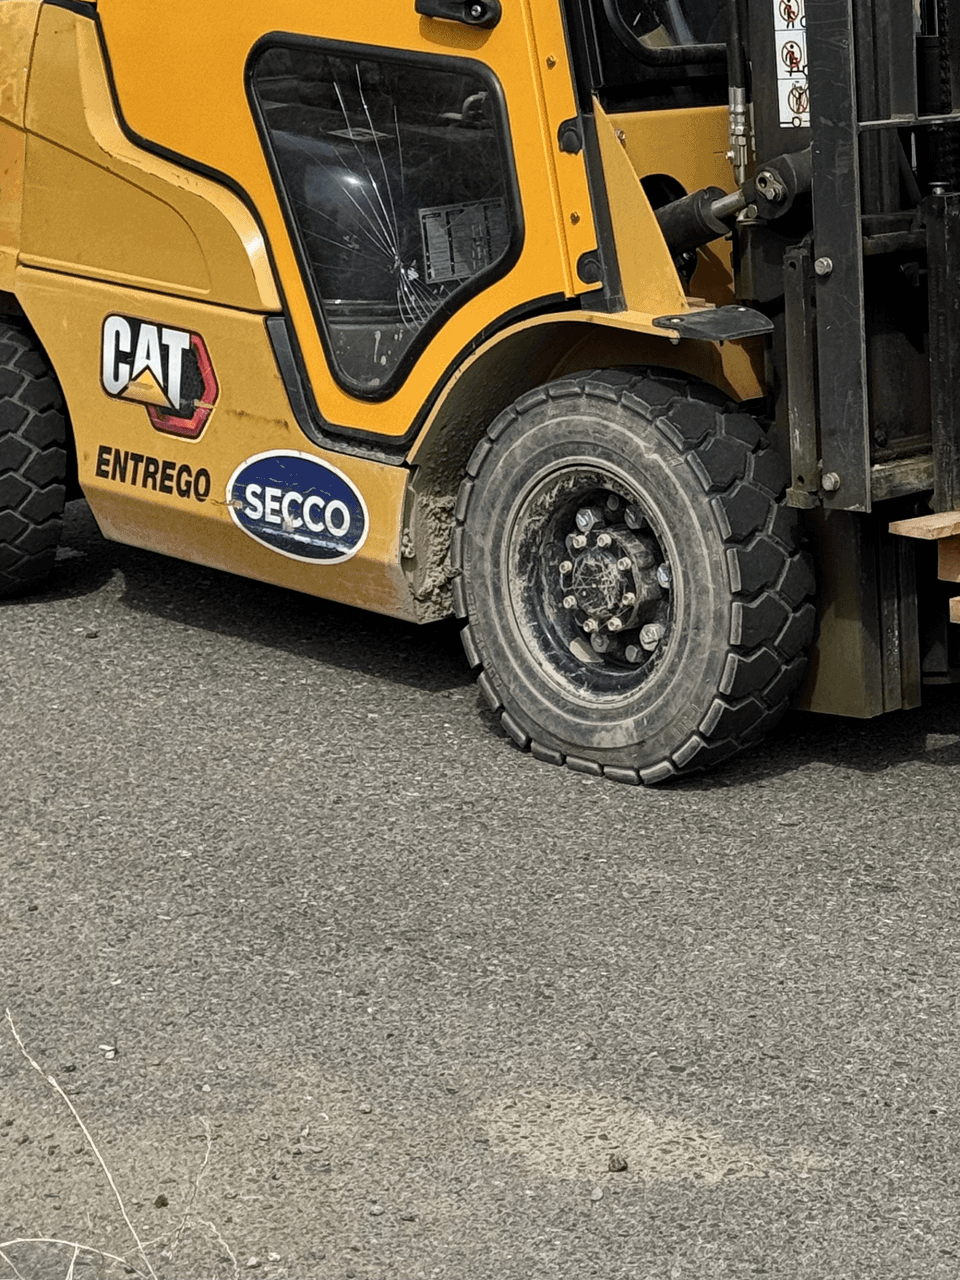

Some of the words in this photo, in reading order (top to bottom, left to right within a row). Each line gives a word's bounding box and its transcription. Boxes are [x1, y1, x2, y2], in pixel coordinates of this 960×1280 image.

[103, 315, 190, 411] CAT
[95, 444, 212, 502] ENTREGO
[244, 483, 351, 537] SECCO
